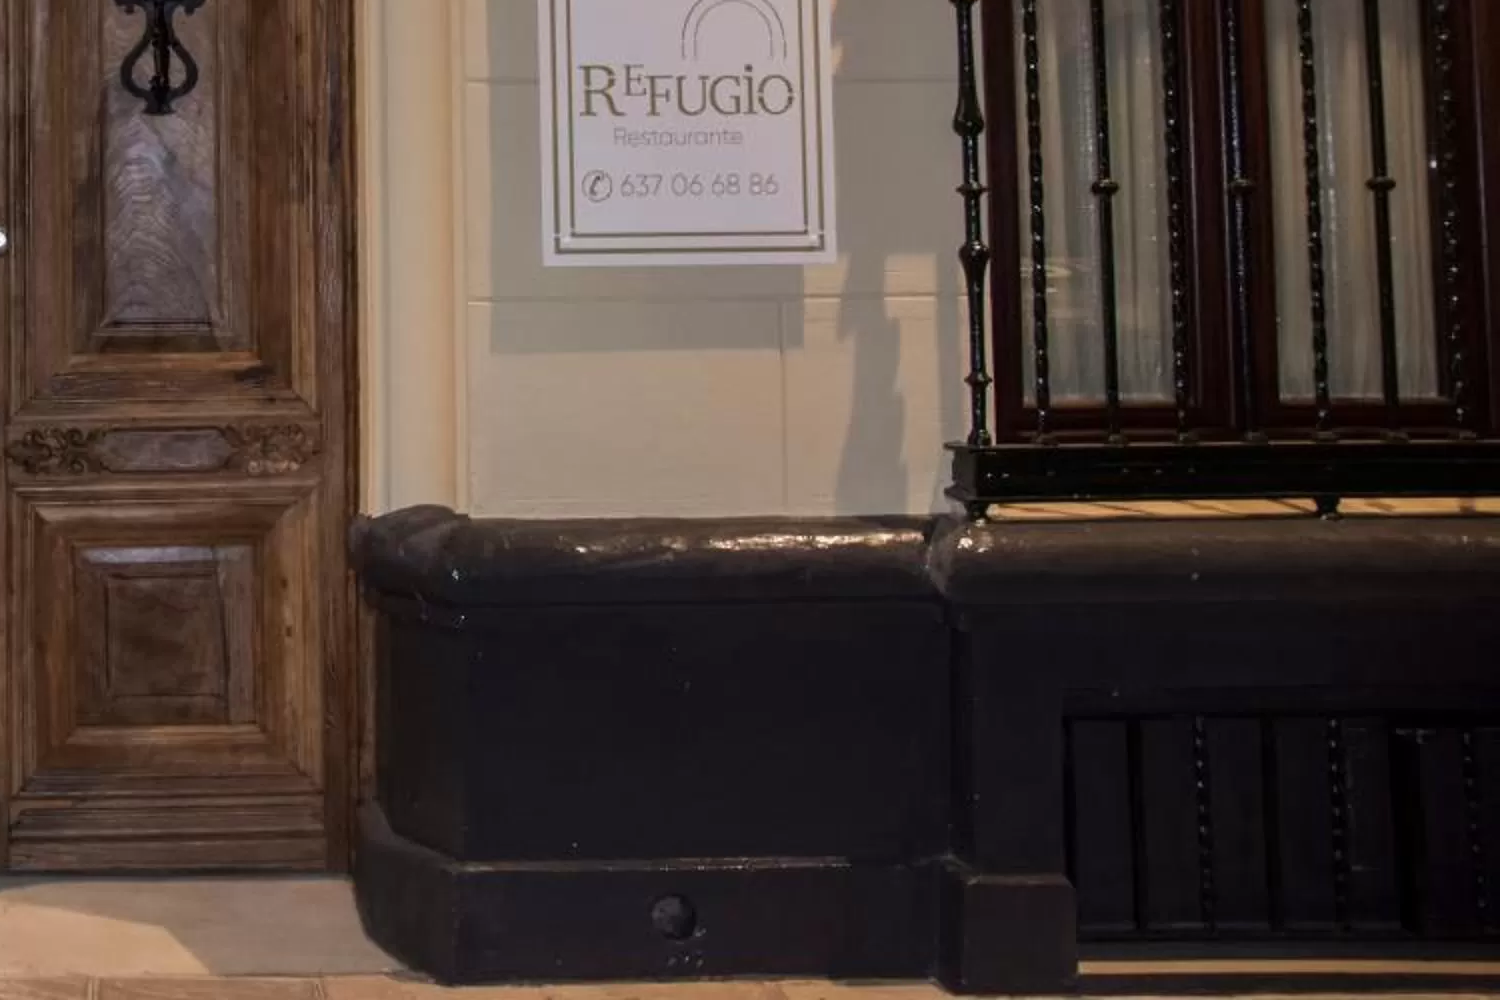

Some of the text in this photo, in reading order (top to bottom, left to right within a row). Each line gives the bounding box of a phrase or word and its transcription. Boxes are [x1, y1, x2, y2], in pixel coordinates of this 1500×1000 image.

[613, 127, 744, 147] Restaurante
[620, 171, 780, 198] 637 06 68 86
